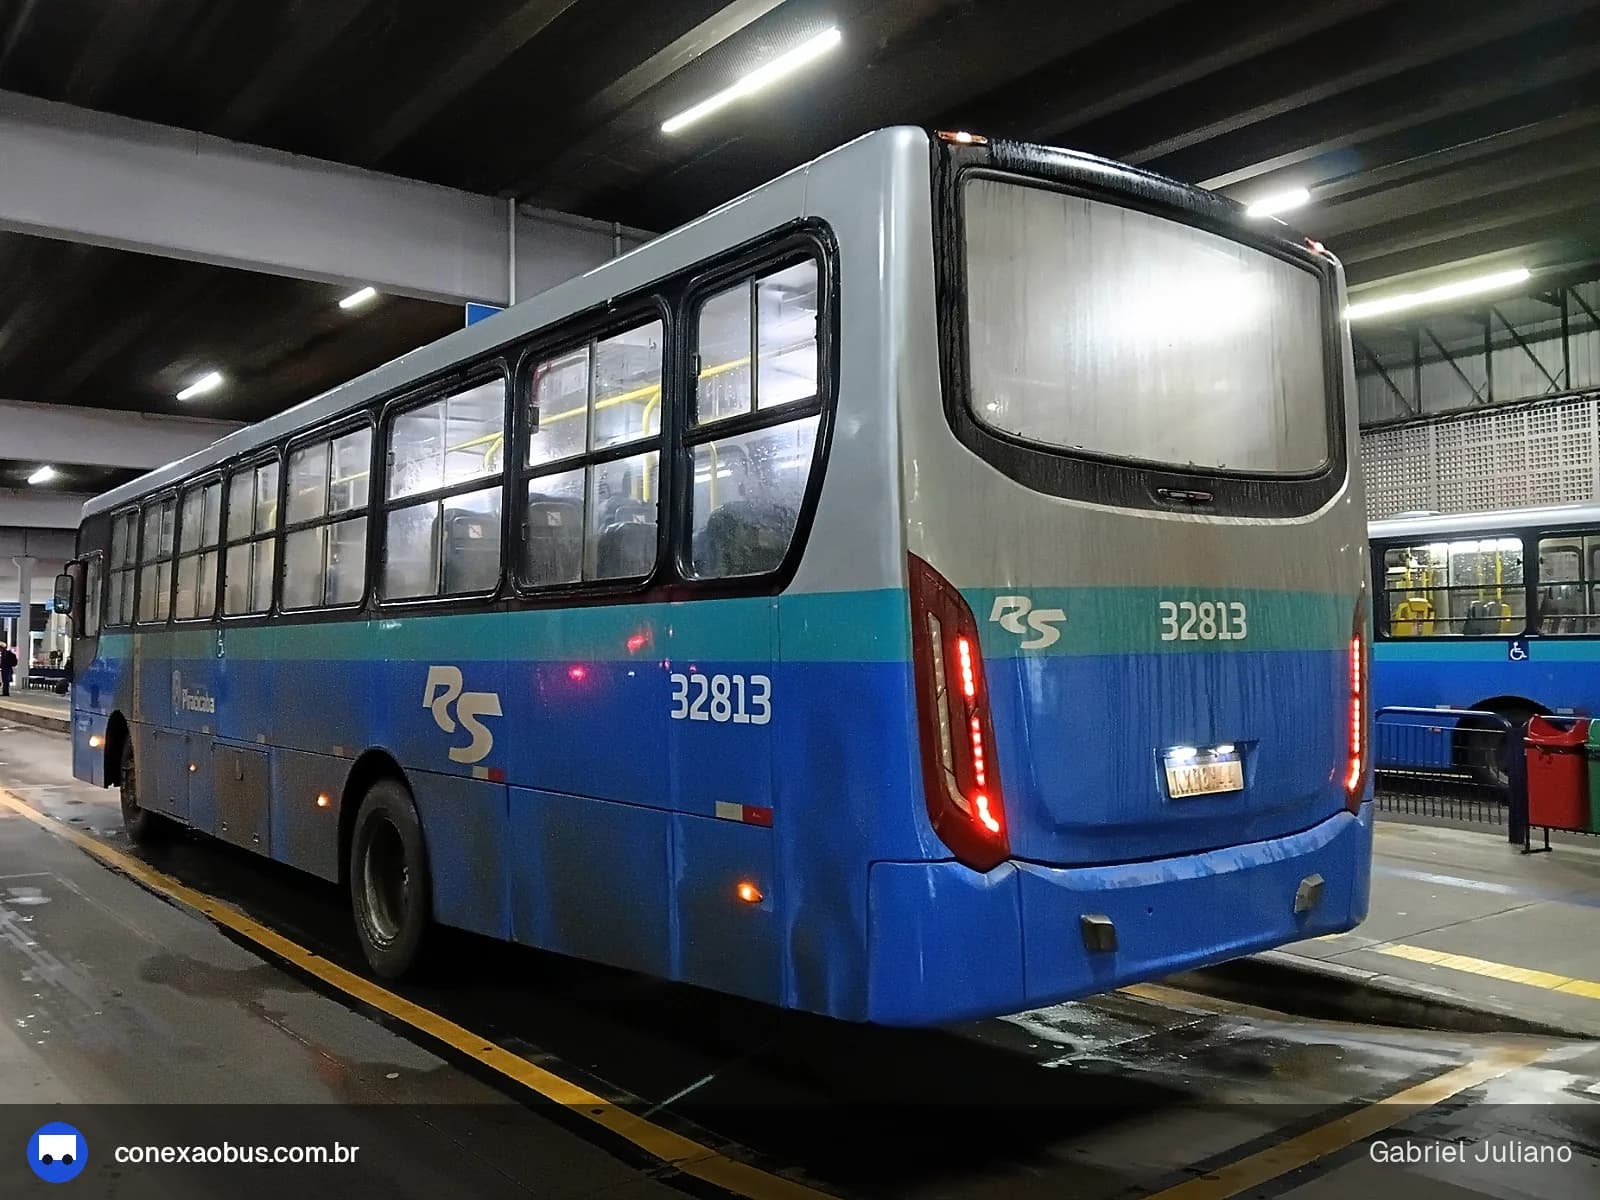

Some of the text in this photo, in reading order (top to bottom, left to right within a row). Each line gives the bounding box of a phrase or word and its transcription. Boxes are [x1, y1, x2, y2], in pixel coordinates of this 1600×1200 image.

[989, 595, 1067, 649] RS
[1159, 601, 1247, 641] 32813
[422, 665, 503, 764] RS
[670, 673, 772, 725] 32813
